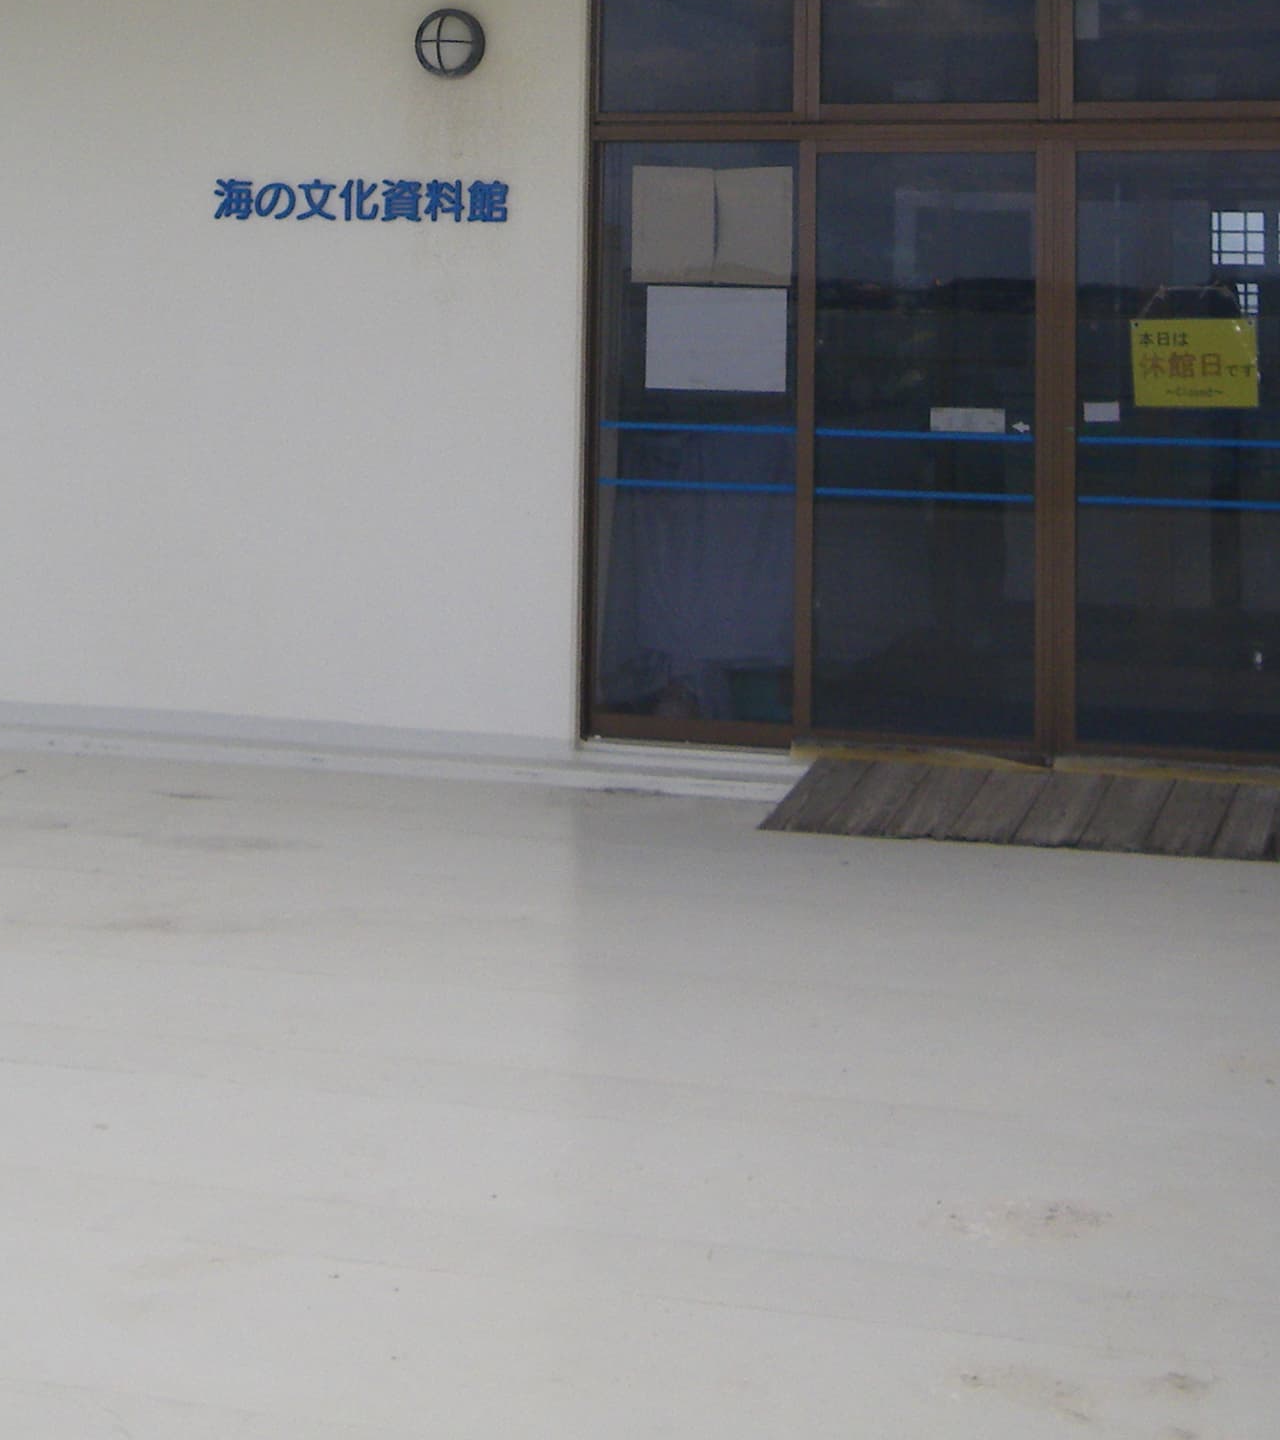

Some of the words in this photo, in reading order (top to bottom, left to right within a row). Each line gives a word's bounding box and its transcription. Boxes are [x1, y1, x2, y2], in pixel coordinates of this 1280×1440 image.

[213, 178, 509, 223] 海の文化資料館
[1138, 331, 1189, 347] 本日は
[1139, 352, 1255, 379] 休館日です
